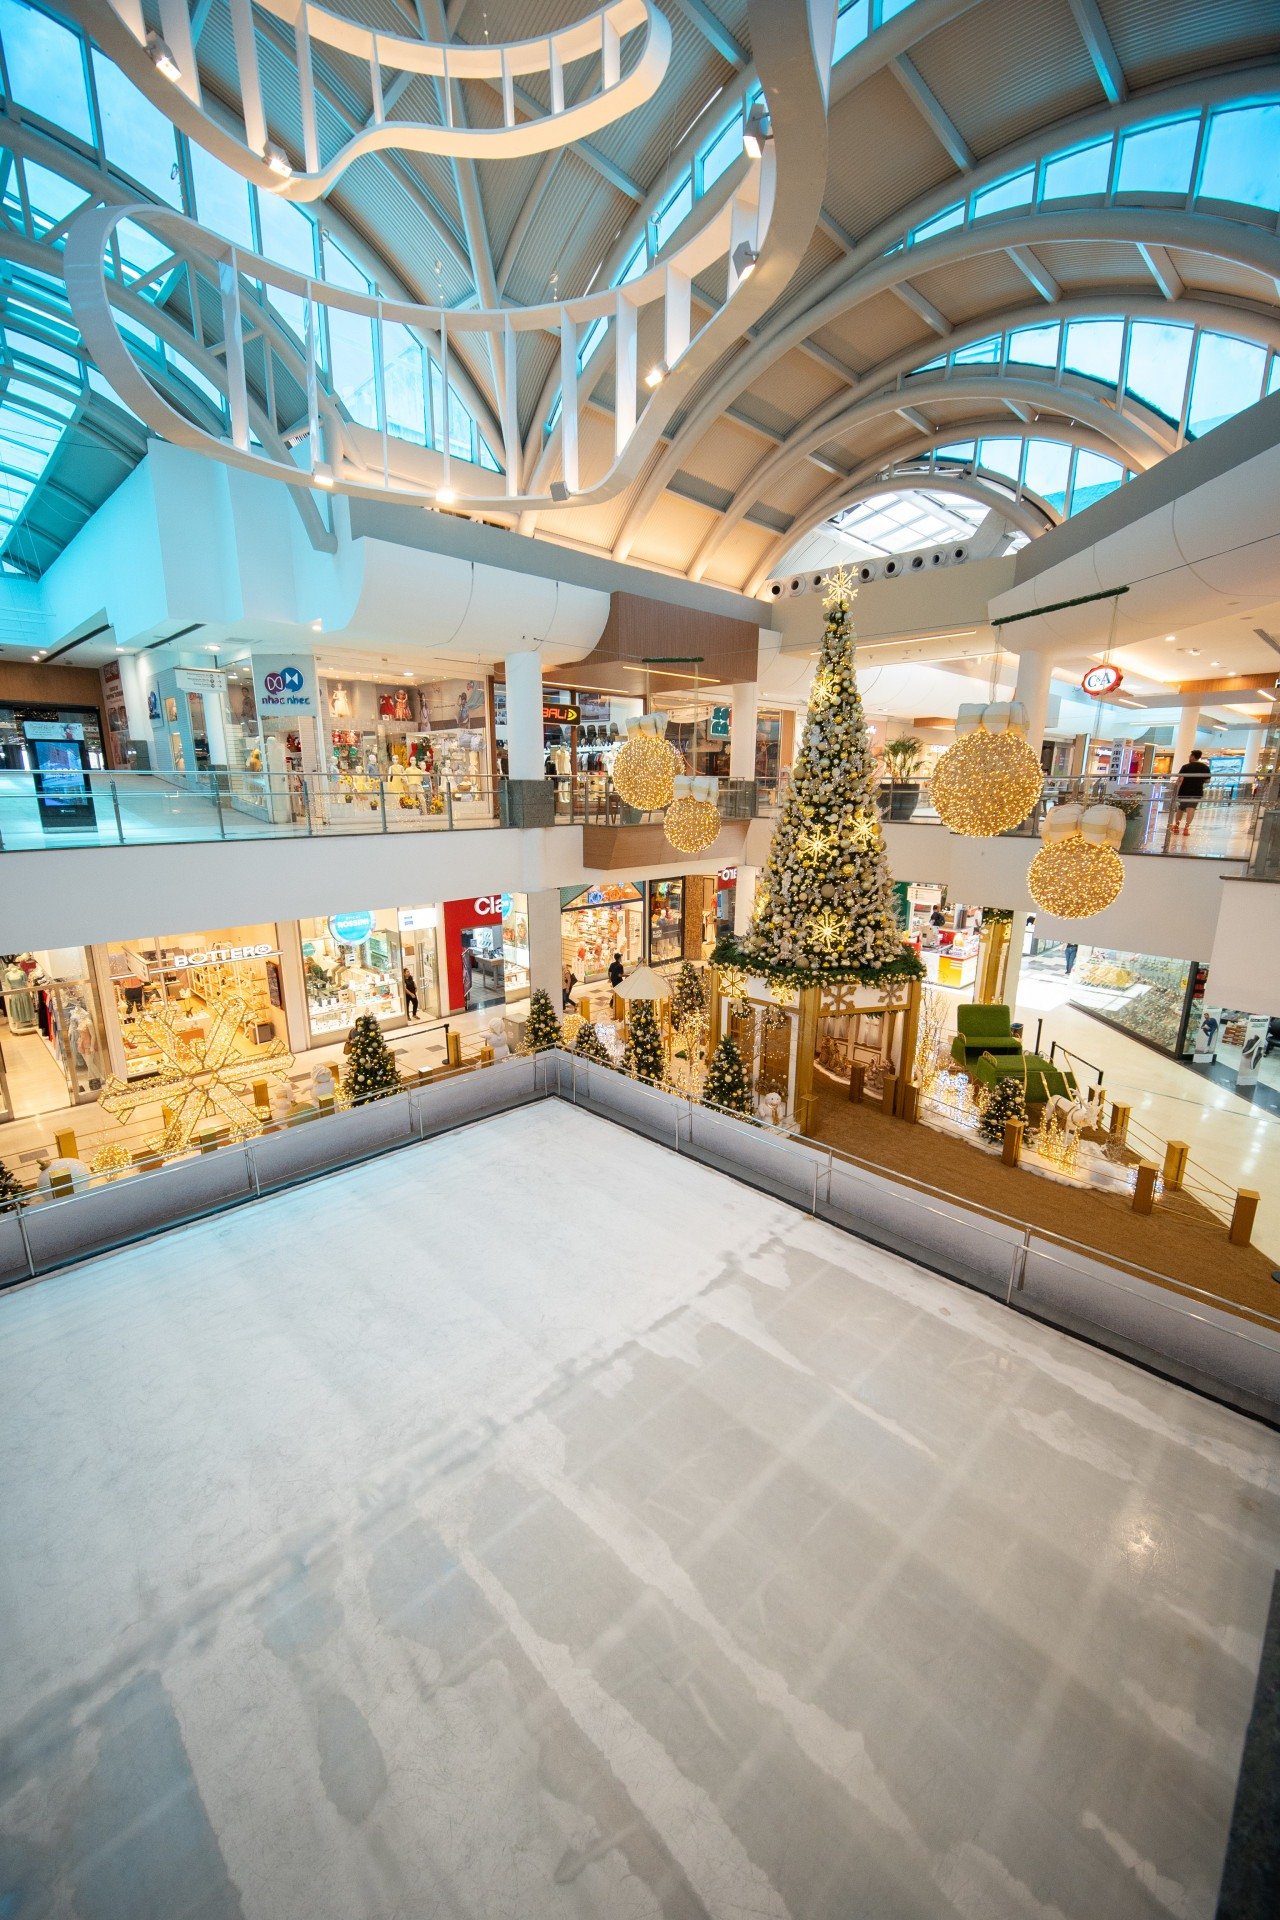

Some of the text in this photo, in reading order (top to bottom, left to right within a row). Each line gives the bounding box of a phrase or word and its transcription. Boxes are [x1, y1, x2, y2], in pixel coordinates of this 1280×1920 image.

[1087, 672, 1111, 688] C&A
[261, 695, 311, 705] nhac nhec
[174, 944, 273, 968] BOTTERO
